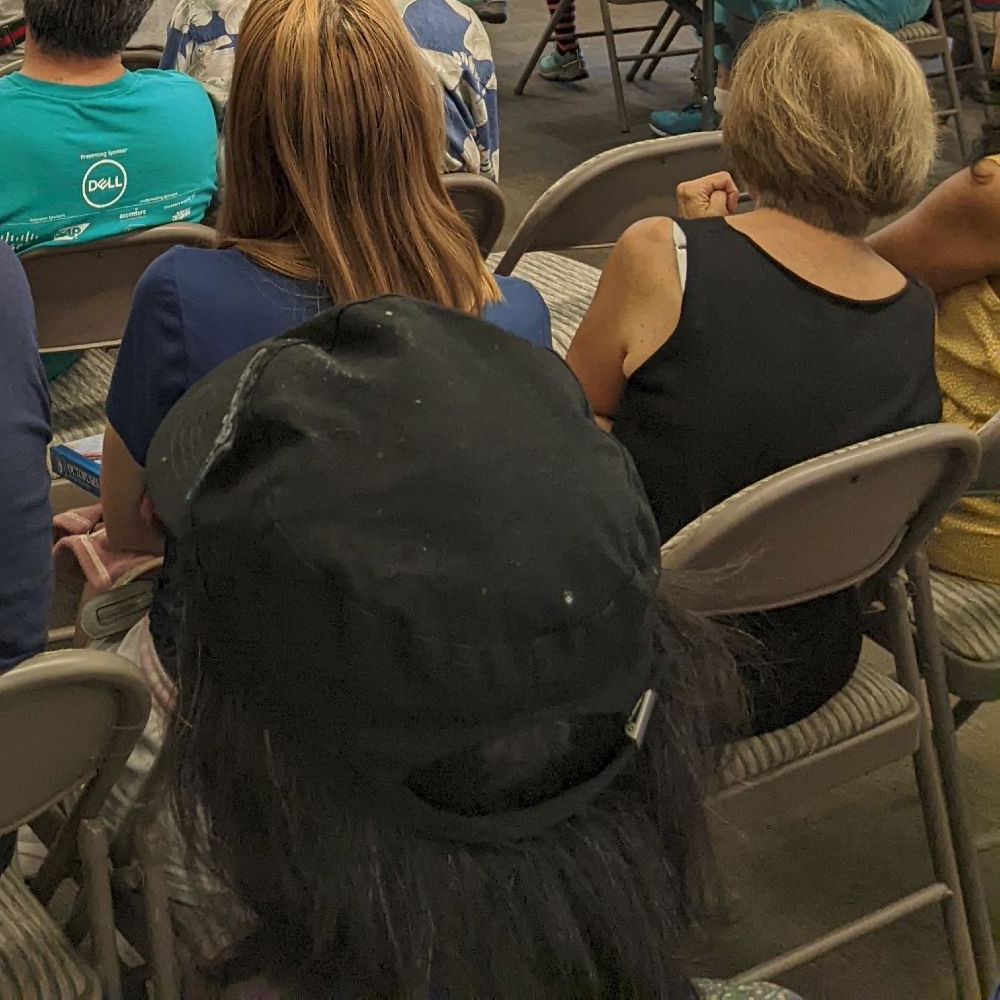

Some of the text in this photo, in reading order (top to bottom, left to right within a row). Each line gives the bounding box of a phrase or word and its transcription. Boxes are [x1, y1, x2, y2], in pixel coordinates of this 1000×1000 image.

[80, 148, 128, 160] Presenting Sponsor
[88, 175, 122, 192] DELL
[119, 209, 147, 219] accenture
[56, 225, 83, 237] SAP
